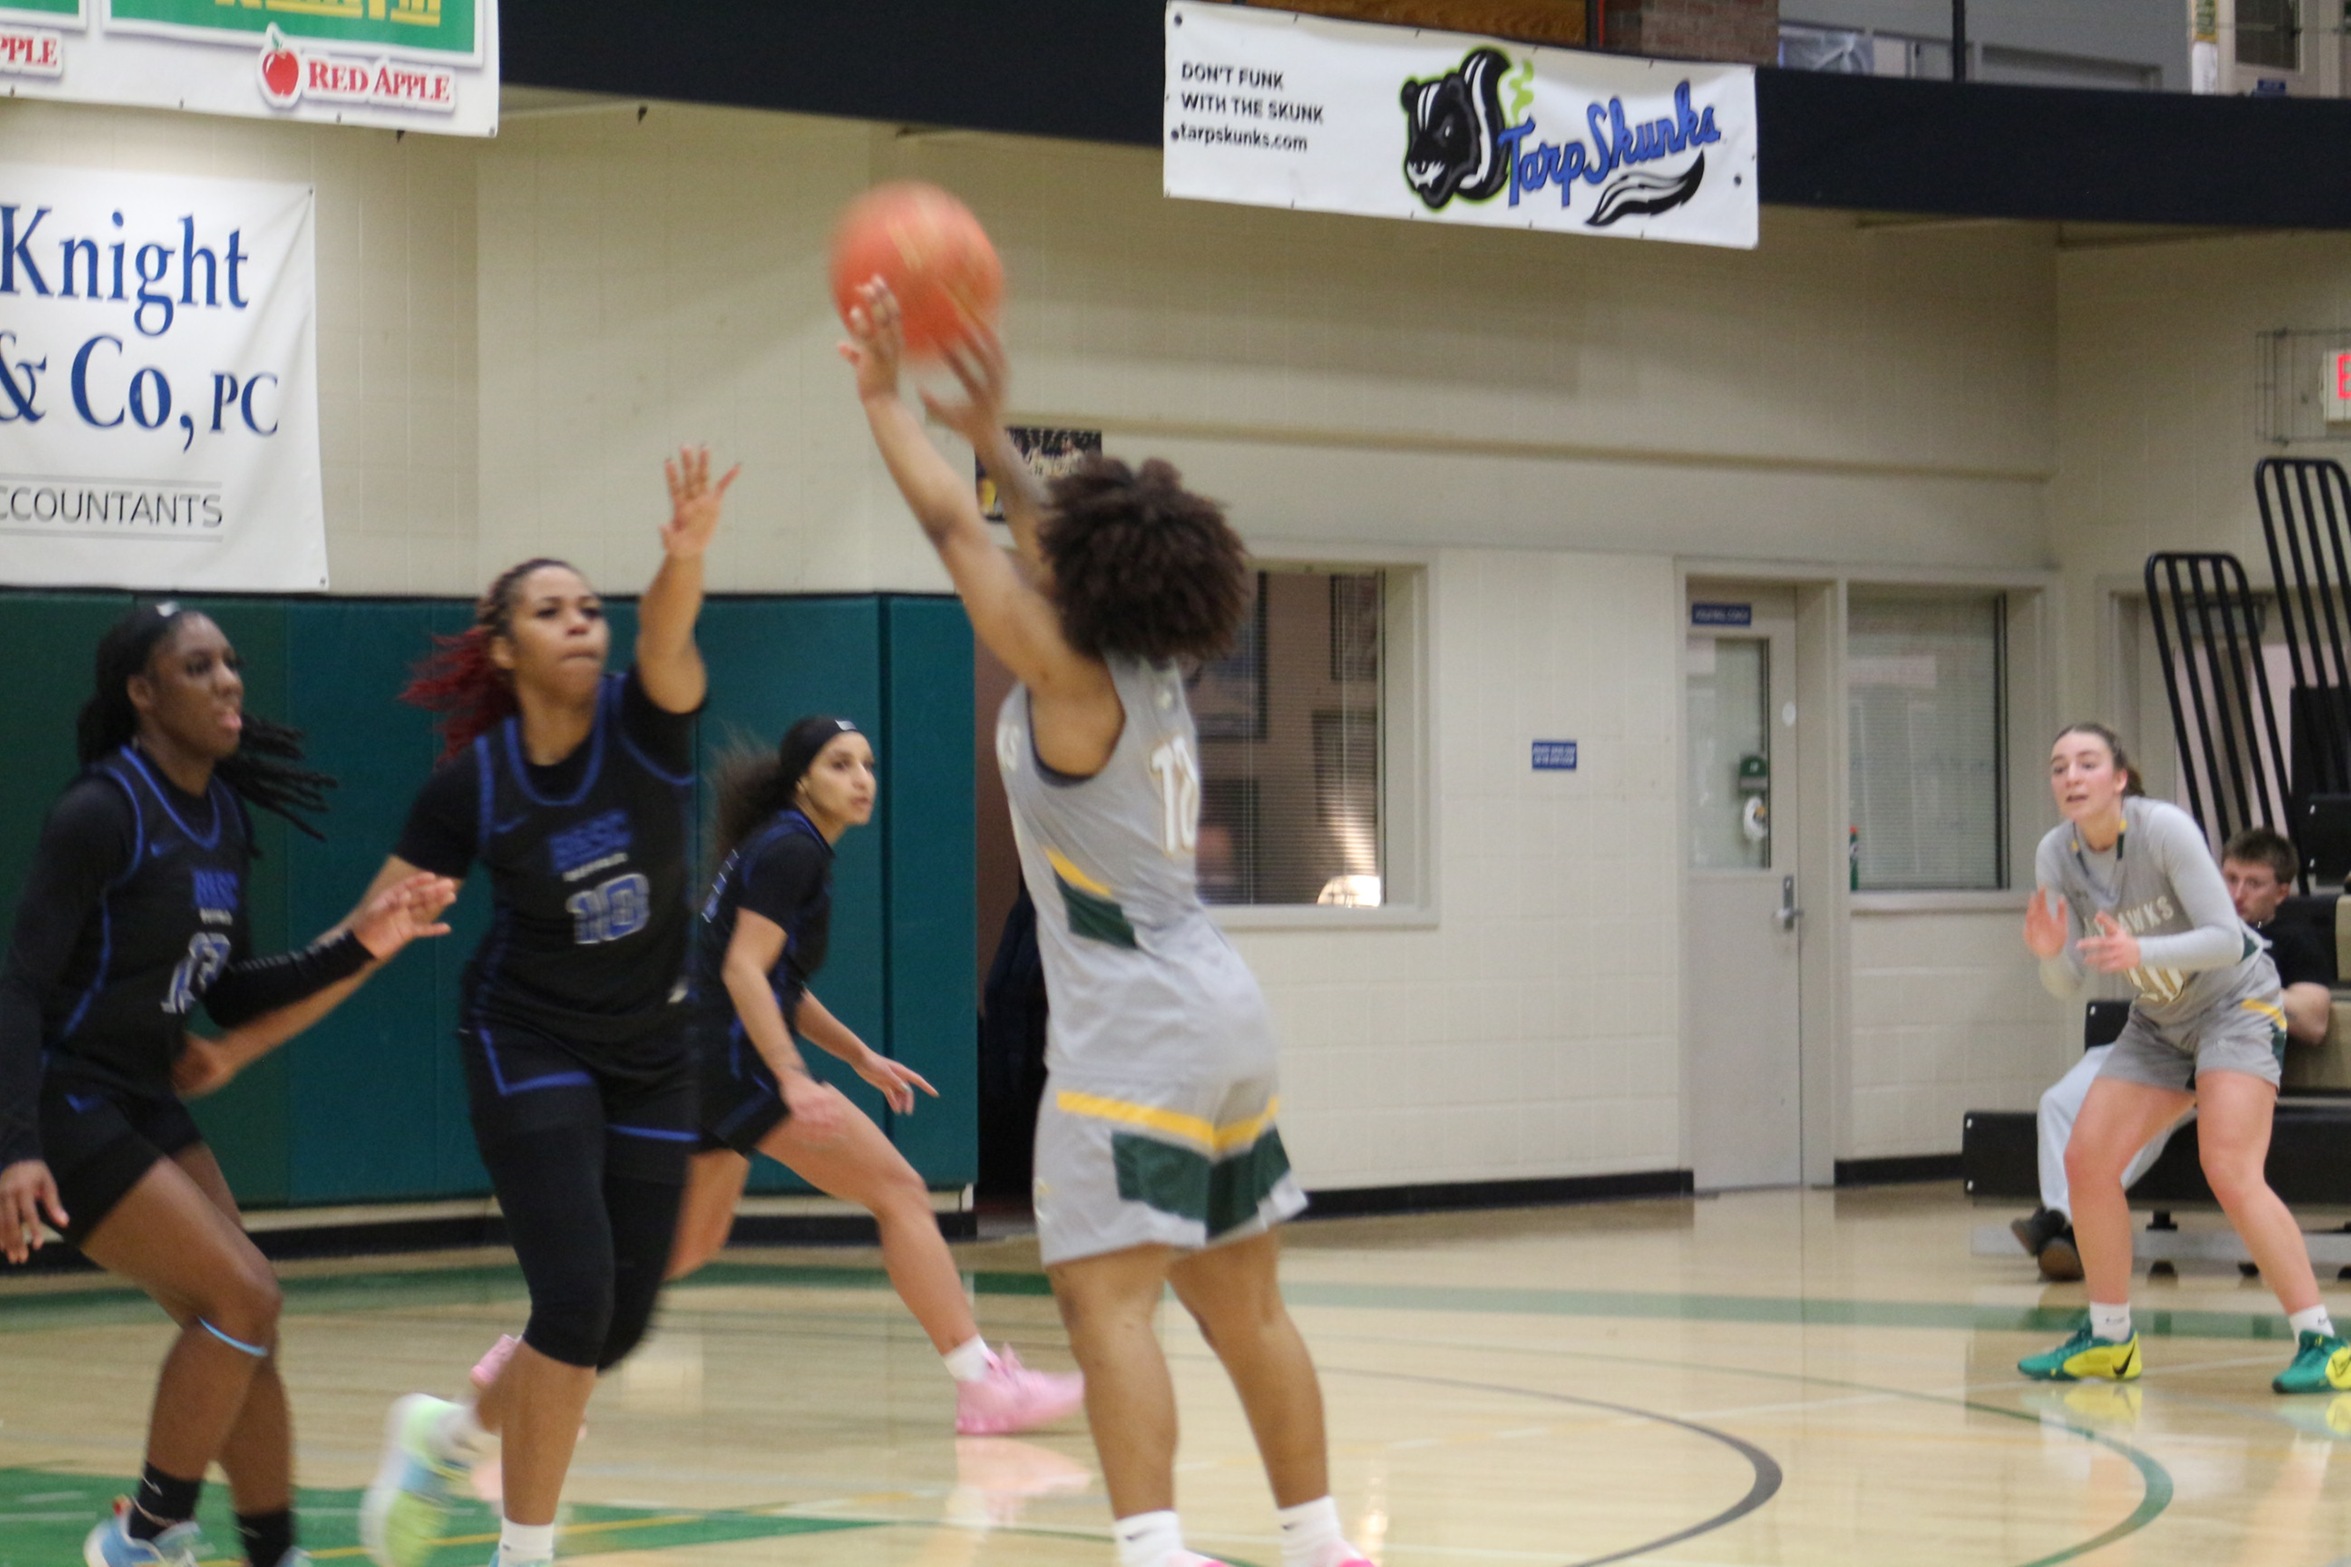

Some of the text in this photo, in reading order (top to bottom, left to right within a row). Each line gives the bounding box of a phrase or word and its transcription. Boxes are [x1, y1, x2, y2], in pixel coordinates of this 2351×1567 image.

[308, 61, 450, 102] RED APPLE
[1181, 62, 1284, 90] DON'T FUNK
[1181, 92, 1323, 124] WITH THE SKUNK
[1180, 123, 1308, 151] tarpskunks.com
[0, 203, 250, 337] Knight
[209, 370, 279, 437] PC
